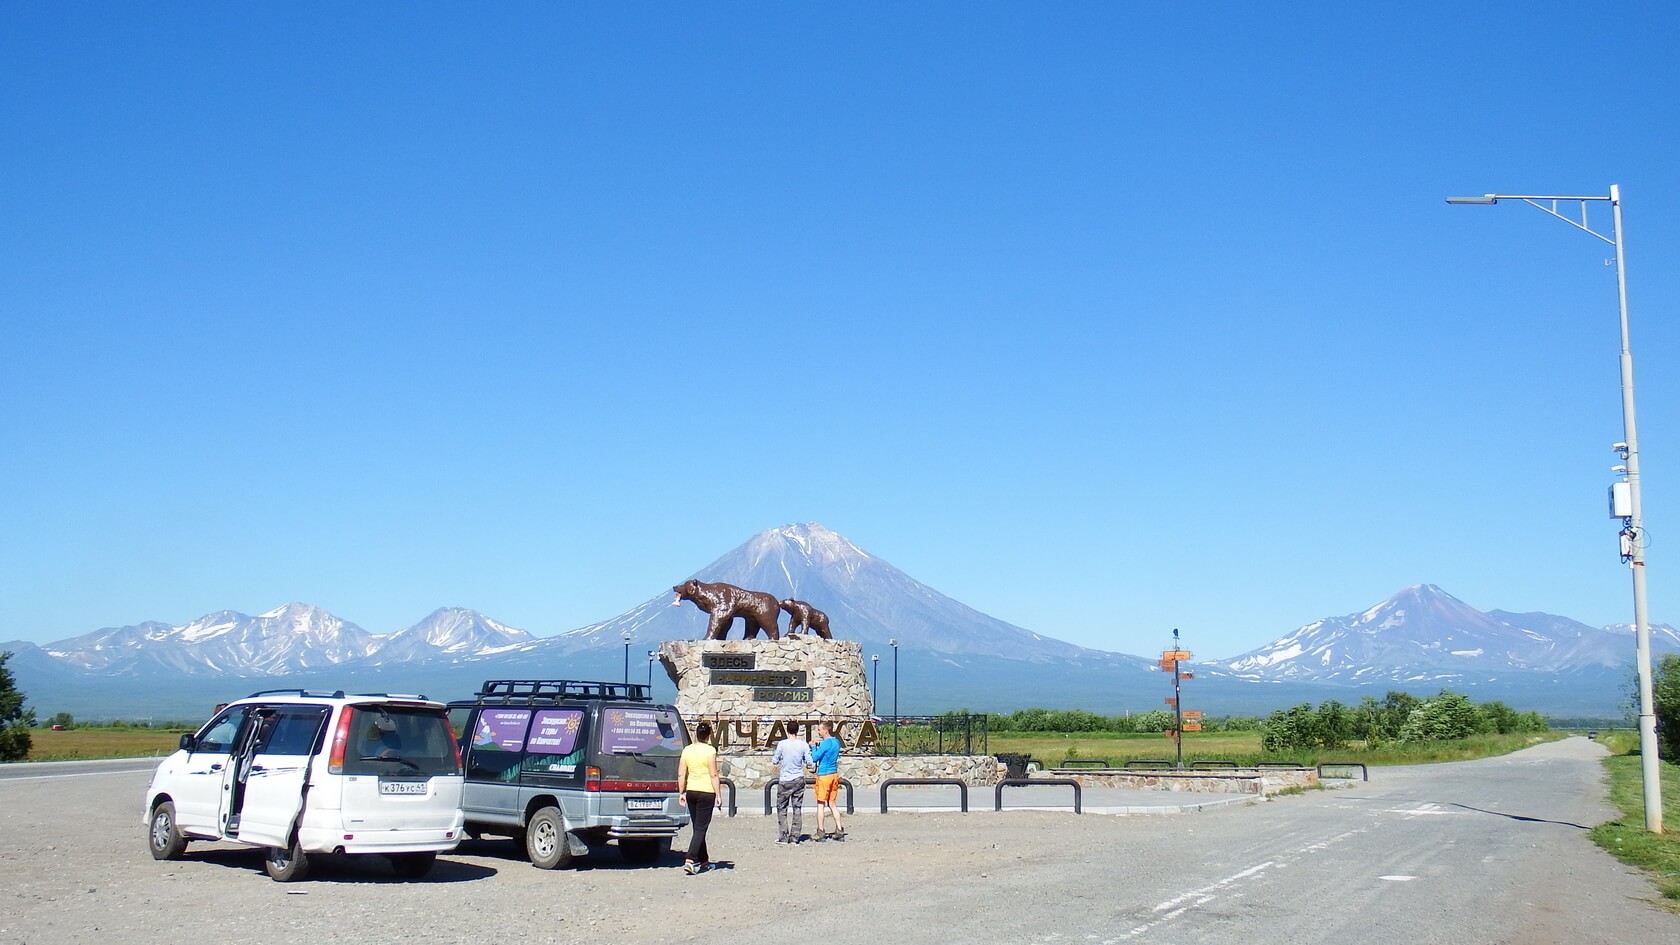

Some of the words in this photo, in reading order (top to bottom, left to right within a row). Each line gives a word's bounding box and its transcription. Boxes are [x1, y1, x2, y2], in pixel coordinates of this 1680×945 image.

[710, 657, 748, 667] ЗДЕСЬ
[718, 675, 799, 686] НАЧИНАЕТСЯ
[758, 691, 809, 701] РОССИЯ
